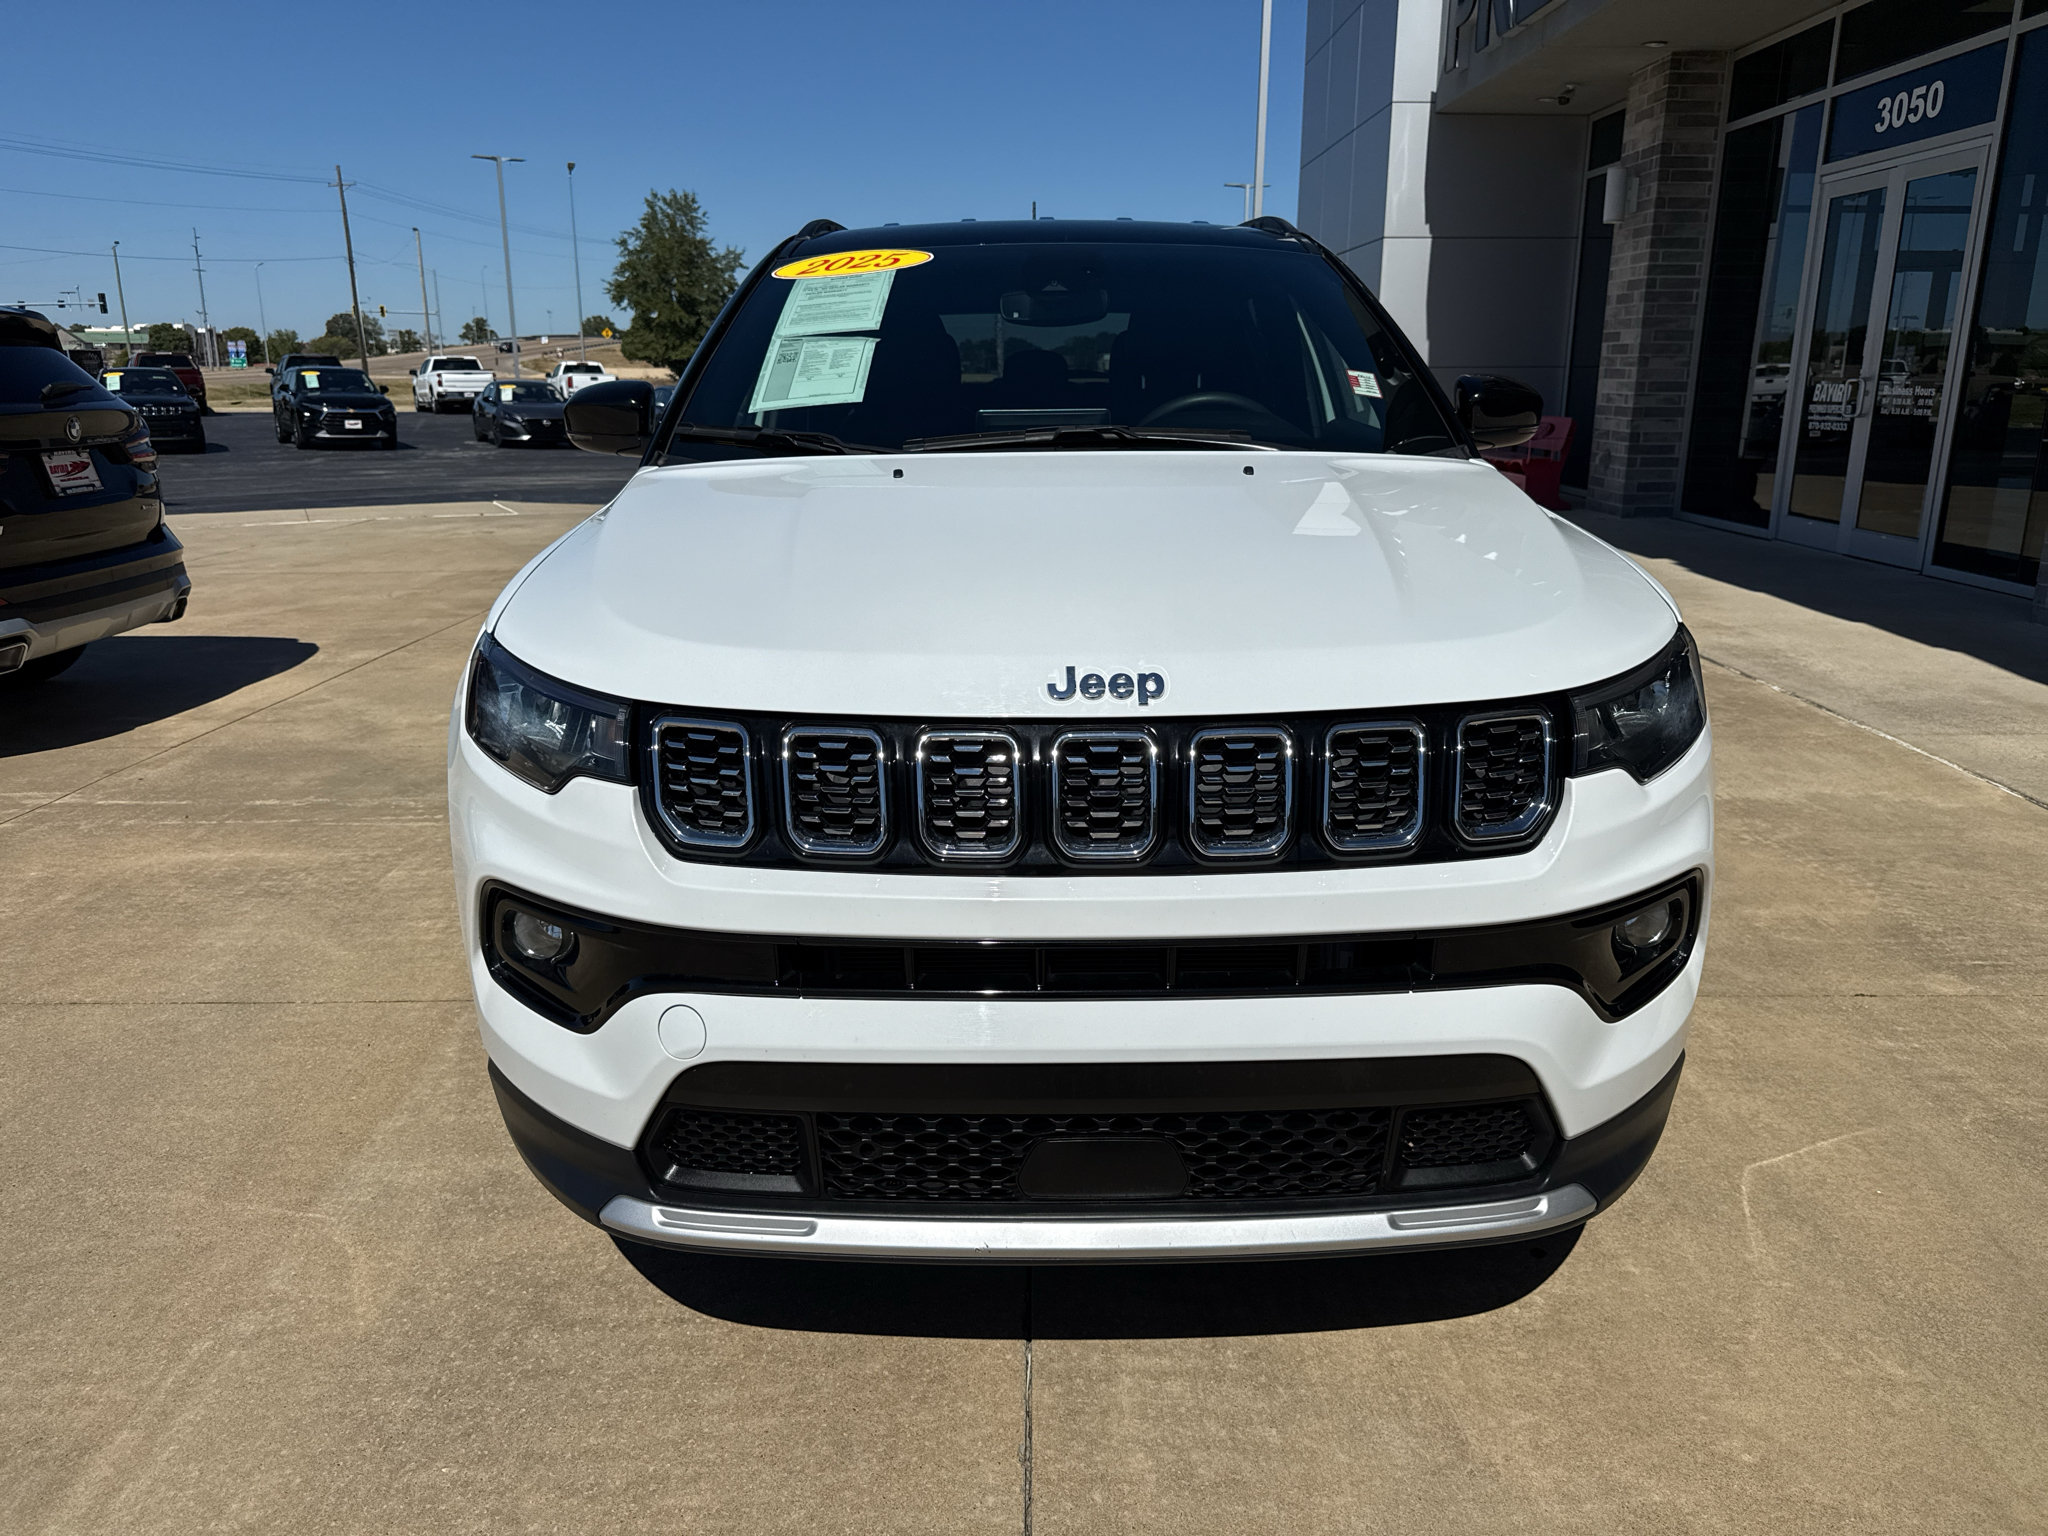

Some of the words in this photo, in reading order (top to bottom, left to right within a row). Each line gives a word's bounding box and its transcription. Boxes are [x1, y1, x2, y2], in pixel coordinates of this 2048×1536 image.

[1874, 80, 1944, 133] 3050
[796, 253, 910, 276] 2025
[1883, 385, 1913, 396] Business
[1914, 385, 1936, 396] Hours
[1047, 666, 1165, 706] Jeep
